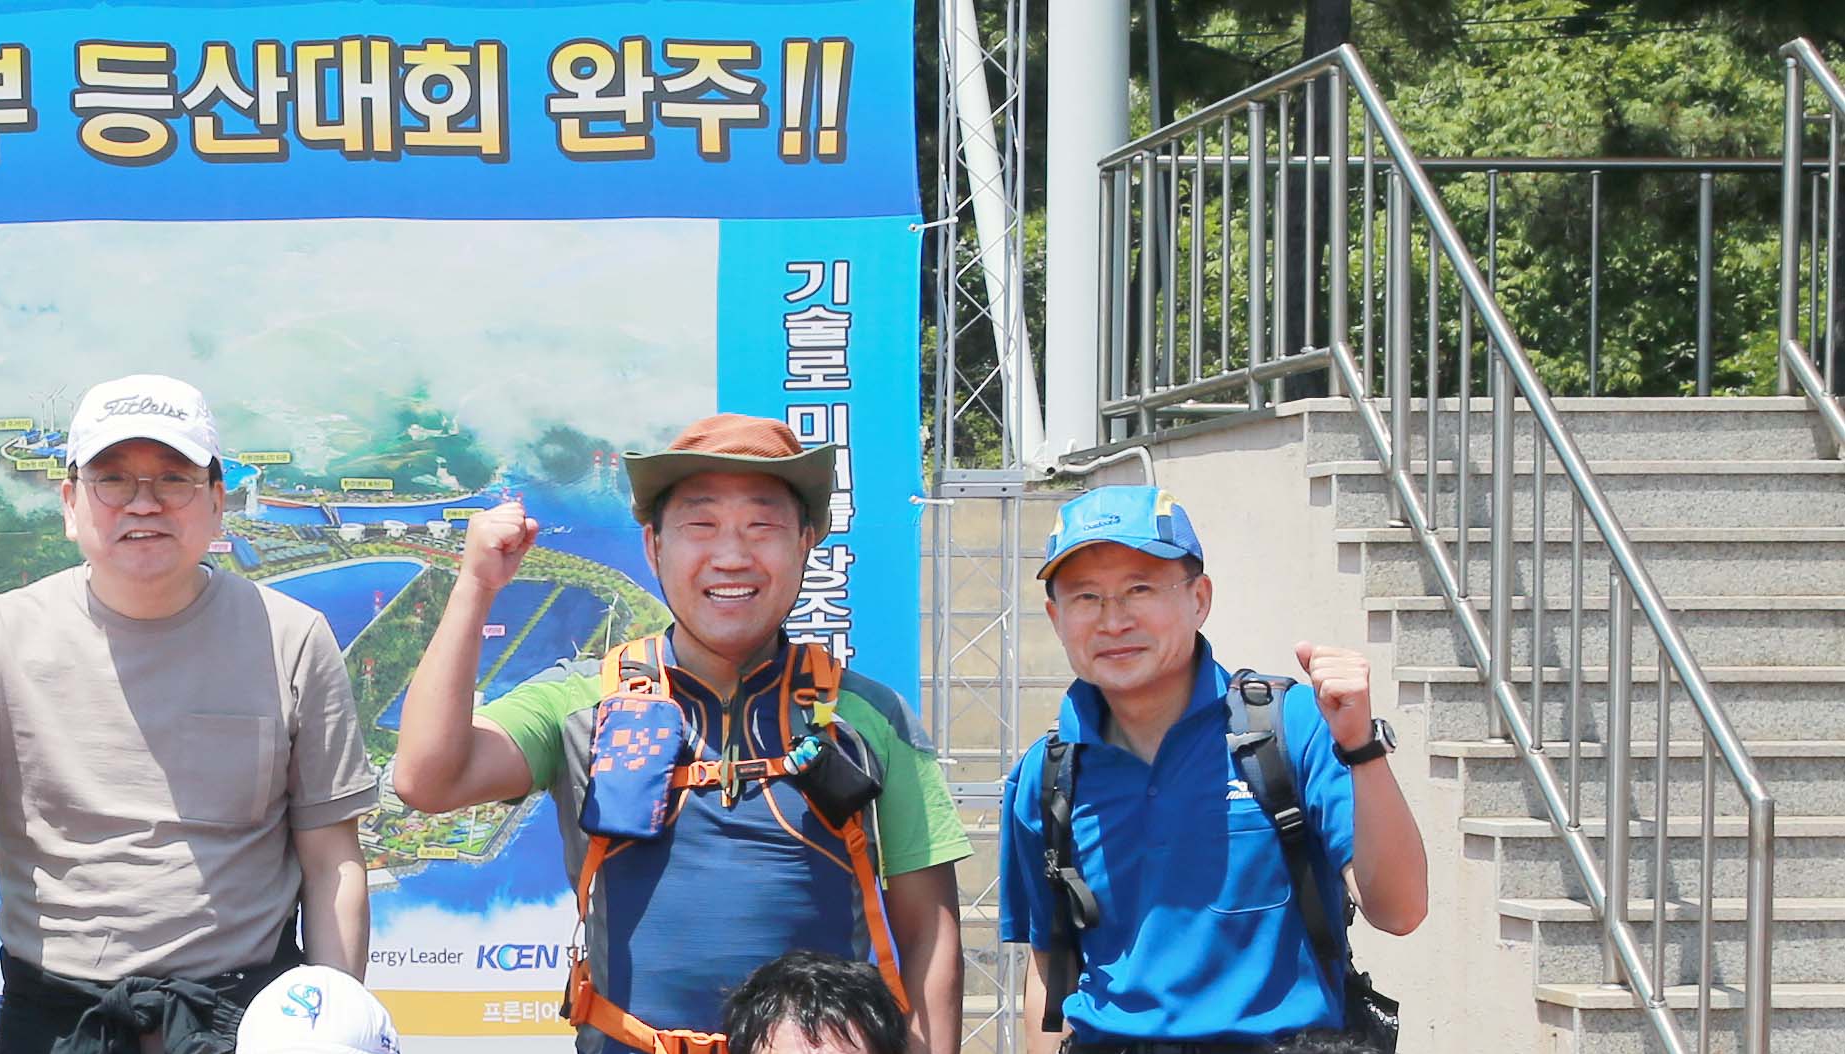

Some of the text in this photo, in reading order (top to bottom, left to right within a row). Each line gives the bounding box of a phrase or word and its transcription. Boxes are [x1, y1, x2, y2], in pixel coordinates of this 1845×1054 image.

[72, 35, 510, 165] 등산대회
[547, 35, 852, 163] 완주!!
[783, 260, 853, 390] 기술로
[410, 948, 463, 964] Leader
[476, 944, 559, 970] KOEN
[482, 1002, 559, 1024] 프론티어
